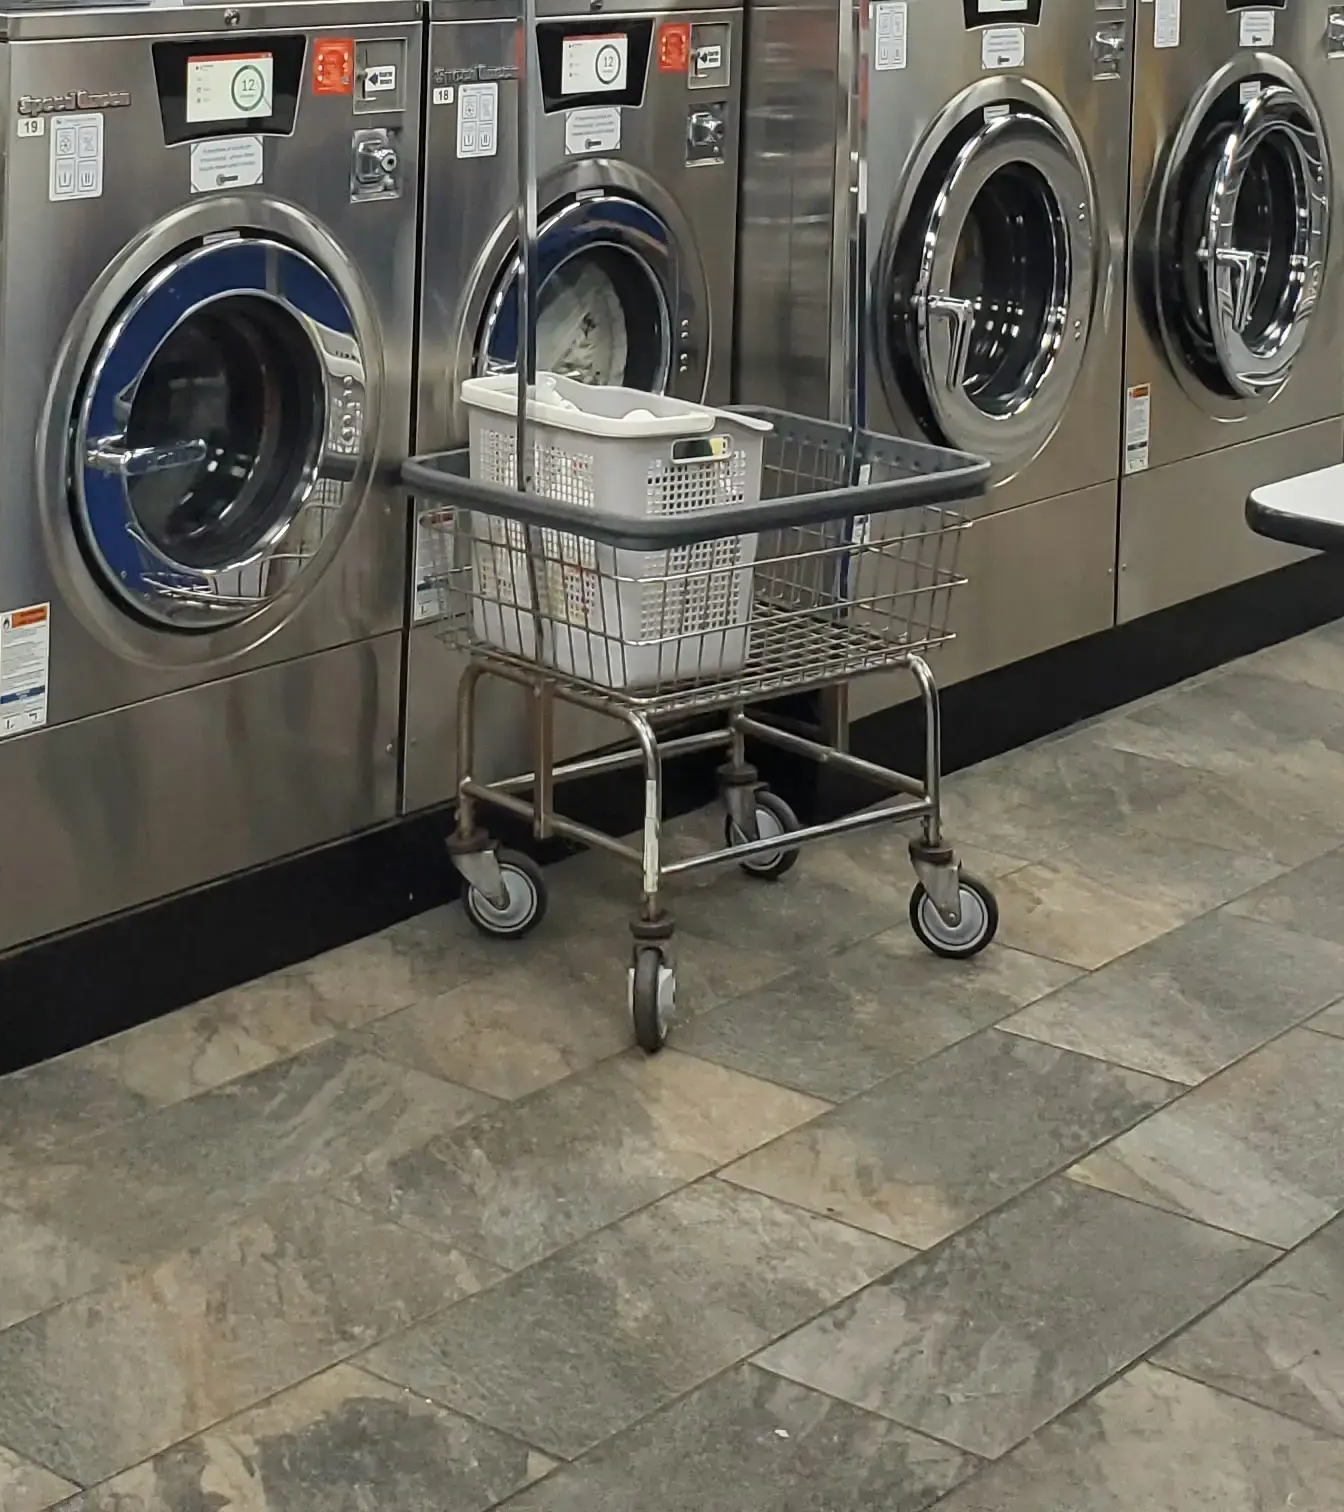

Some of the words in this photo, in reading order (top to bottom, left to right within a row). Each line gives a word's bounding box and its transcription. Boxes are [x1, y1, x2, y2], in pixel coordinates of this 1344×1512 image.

[603, 55, 614, 68] 12
[242, 79, 256, 92] 12
[438, 89, 449, 101] 18
[23, 120, 38, 133] 19
